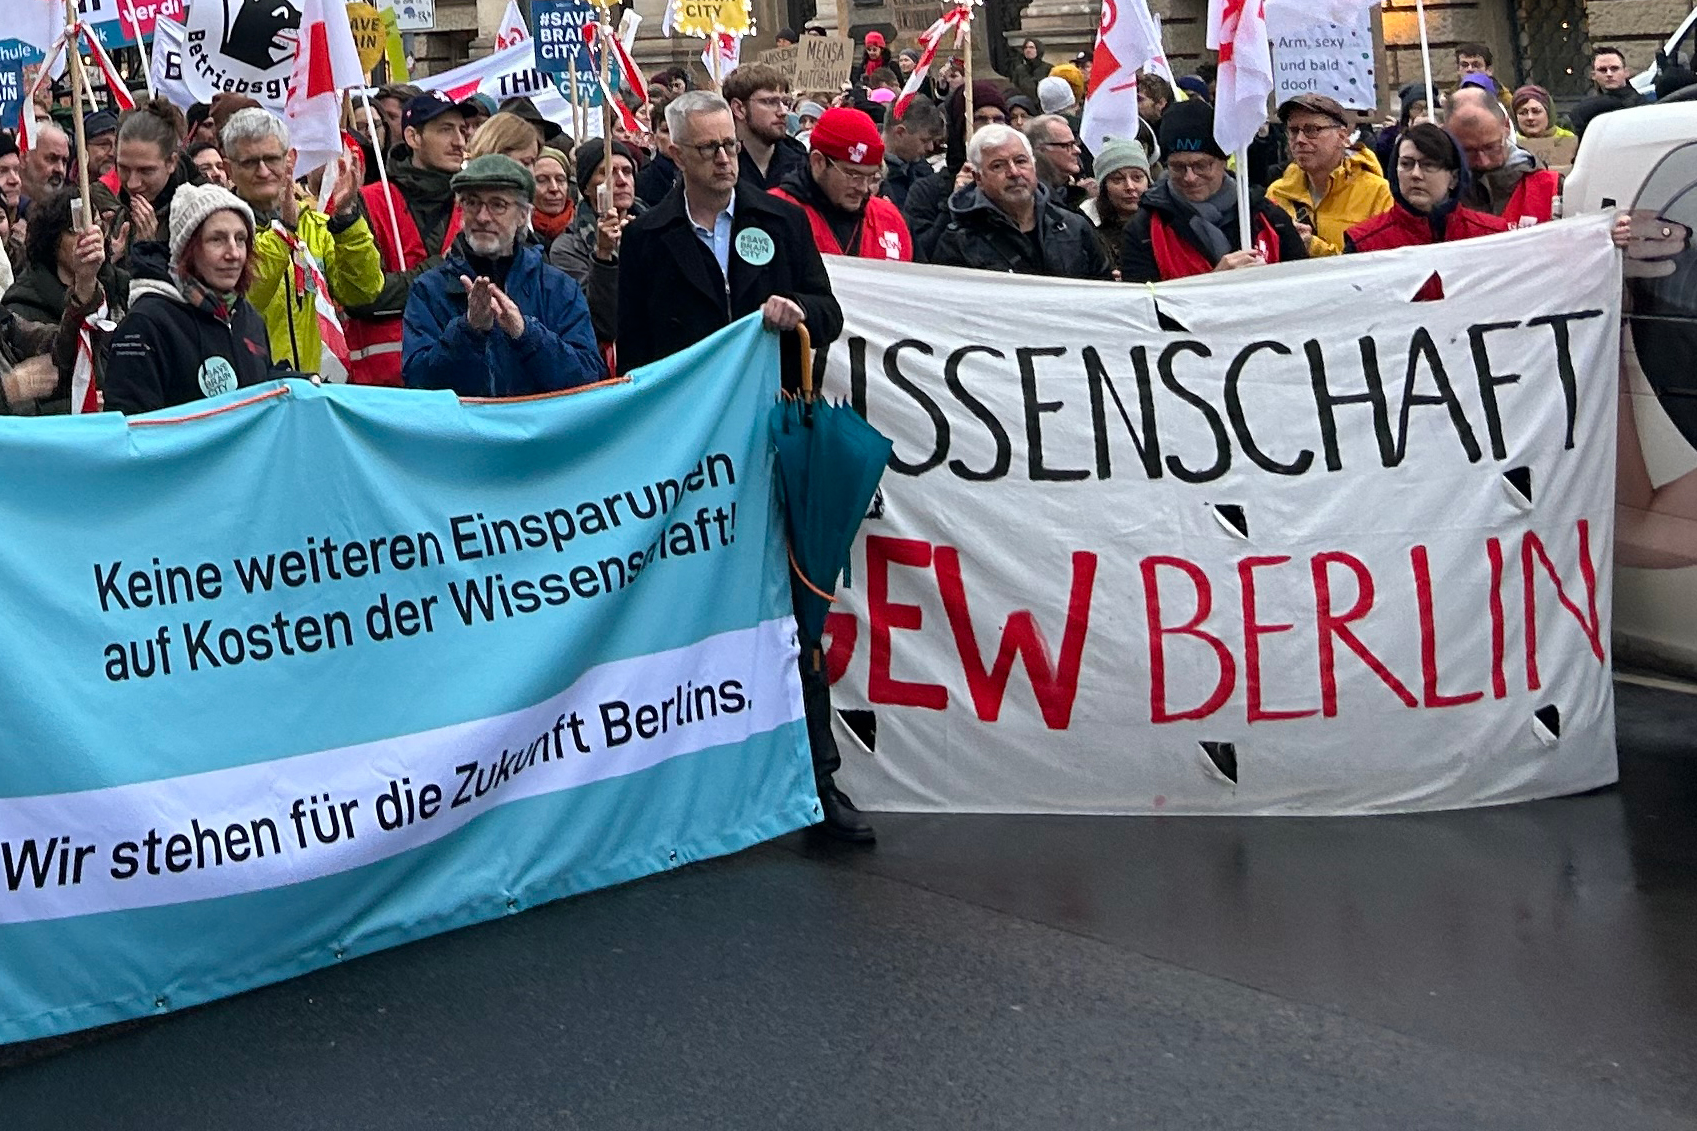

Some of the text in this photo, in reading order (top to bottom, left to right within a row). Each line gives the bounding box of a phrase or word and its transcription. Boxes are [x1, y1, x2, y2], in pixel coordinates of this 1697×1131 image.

[685, 3, 722, 19] CITY
[539, 26, 583, 43] BRAI
[1278, 36, 1345, 50] Arm, sexy
[541, 43, 582, 59] CITY
[806, 40, 845, 62] MENSA
[1280, 58, 1340, 72] und bald
[560, 80, 597, 97] CTY
[1280, 78, 1318, 92] doof!
[815, 308, 1603, 482] ISSENSCHAFT
[95, 557, 223, 612] Keine
[235, 529, 445, 593] weiteren
[1140, 518, 1605, 725] BERLIN
[104, 623, 173, 682] auf
[186, 606, 354, 669] Kosten
[366, 585, 439, 642] der
[0, 676, 754, 890] Wir stehen für die Zukunft Berlins.
